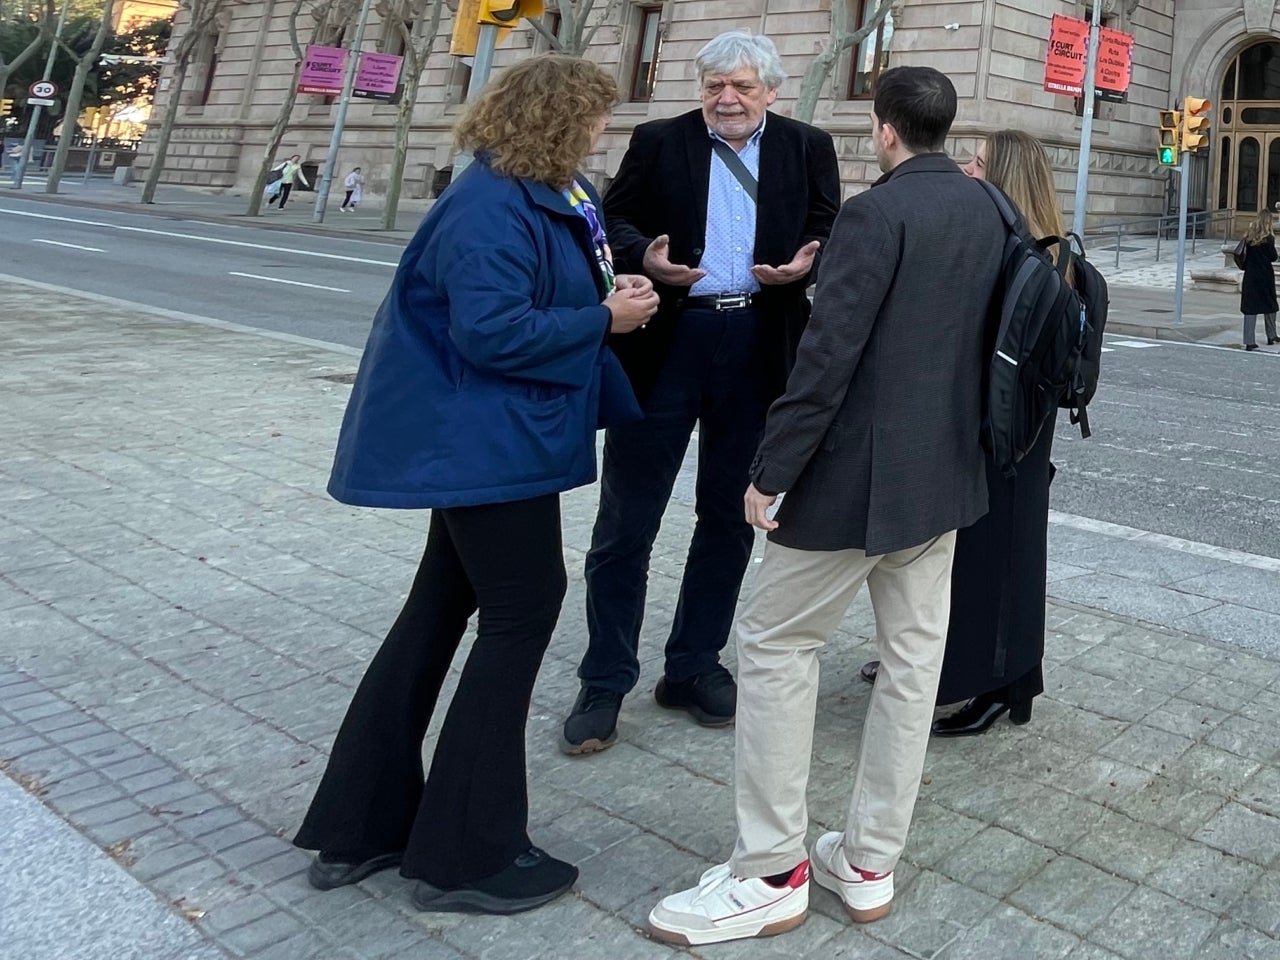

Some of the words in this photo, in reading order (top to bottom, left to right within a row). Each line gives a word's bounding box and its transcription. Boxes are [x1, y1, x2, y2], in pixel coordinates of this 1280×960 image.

[1055, 41, 1075, 51] CURT
[1054, 48, 1083, 61] CIRCUIT
[36, 86, 52, 94] 30
